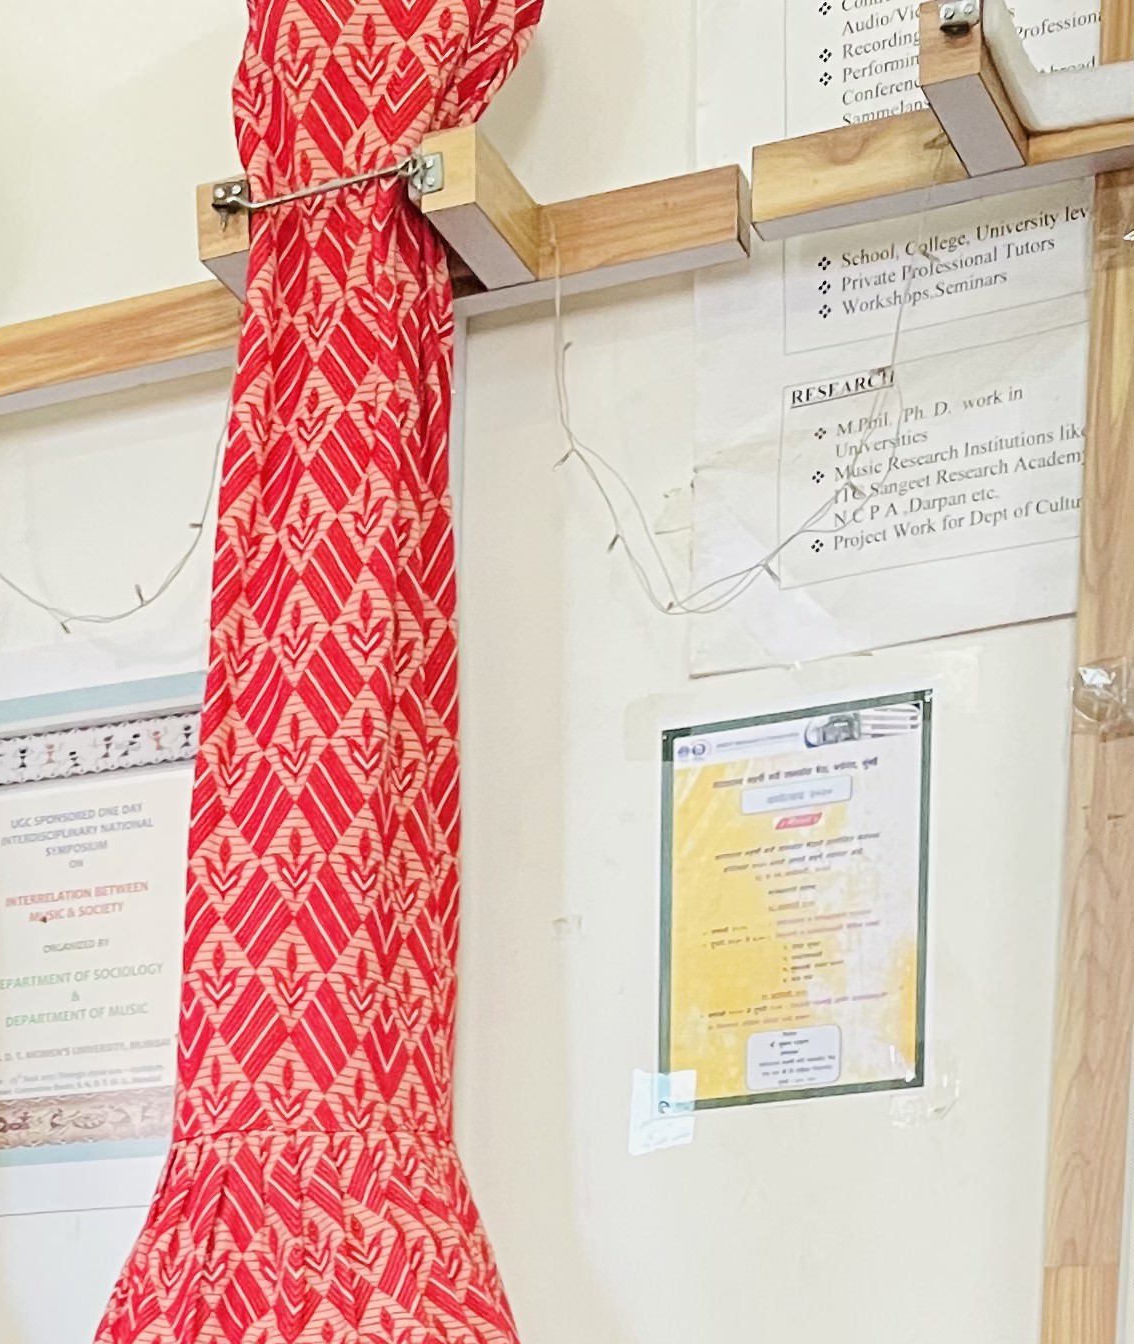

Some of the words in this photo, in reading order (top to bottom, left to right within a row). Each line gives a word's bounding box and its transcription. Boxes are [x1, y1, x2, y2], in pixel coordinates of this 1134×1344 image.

[841, 242, 900, 268] School,
[976, 210, 1059, 241] University
[842, 271, 896, 292] Private
[902, 246, 998, 281] Professional
[1003, 238, 1055, 259] Tutors
[962, 389, 1003, 410] work
[1008, 385, 1023, 402] in
[835, 460, 883, 482] Music
[889, 445, 959, 471] Research
[964, 431, 1055, 458] Institutions
[836, 429, 928, 458] Universities
[869, 474, 931, 498] Sangeet
[935, 458, 1009, 486] Research
[1014, 450, 1085, 474] Academ
[834, 529, 888, 551] Project
[893, 518, 936, 538] Work
[942, 514, 965, 531] for
[969, 508, 1008, 527] Dept
[1013, 500, 1034, 519] of
[34, 809, 96, 827] SPONSORED
[98, 805, 119, 819] ONE
[122, 802, 144, 815] DAY
[0, 827, 98, 847] INTERDISCIPLINARY
[100, 818, 154, 834] NATIONAL
[45, 840, 108, 857] SYMPOSIUM
[68, 859, 84, 869] ON
[5, 888, 92, 908] INTERRELATION
[94, 881, 149, 898] BETWEEN
[28, 907, 65, 923] MUSIC
[78, 901, 125, 917] SOCIETY
[74, 969, 91, 983] OF
[93, 962, 164, 981] SOCIOLOGY
[5, 1007, 87, 1028] DEPARTMENT
[89, 1006, 106, 1019] OF
[108, 1002, 149, 1017] MUSIC
